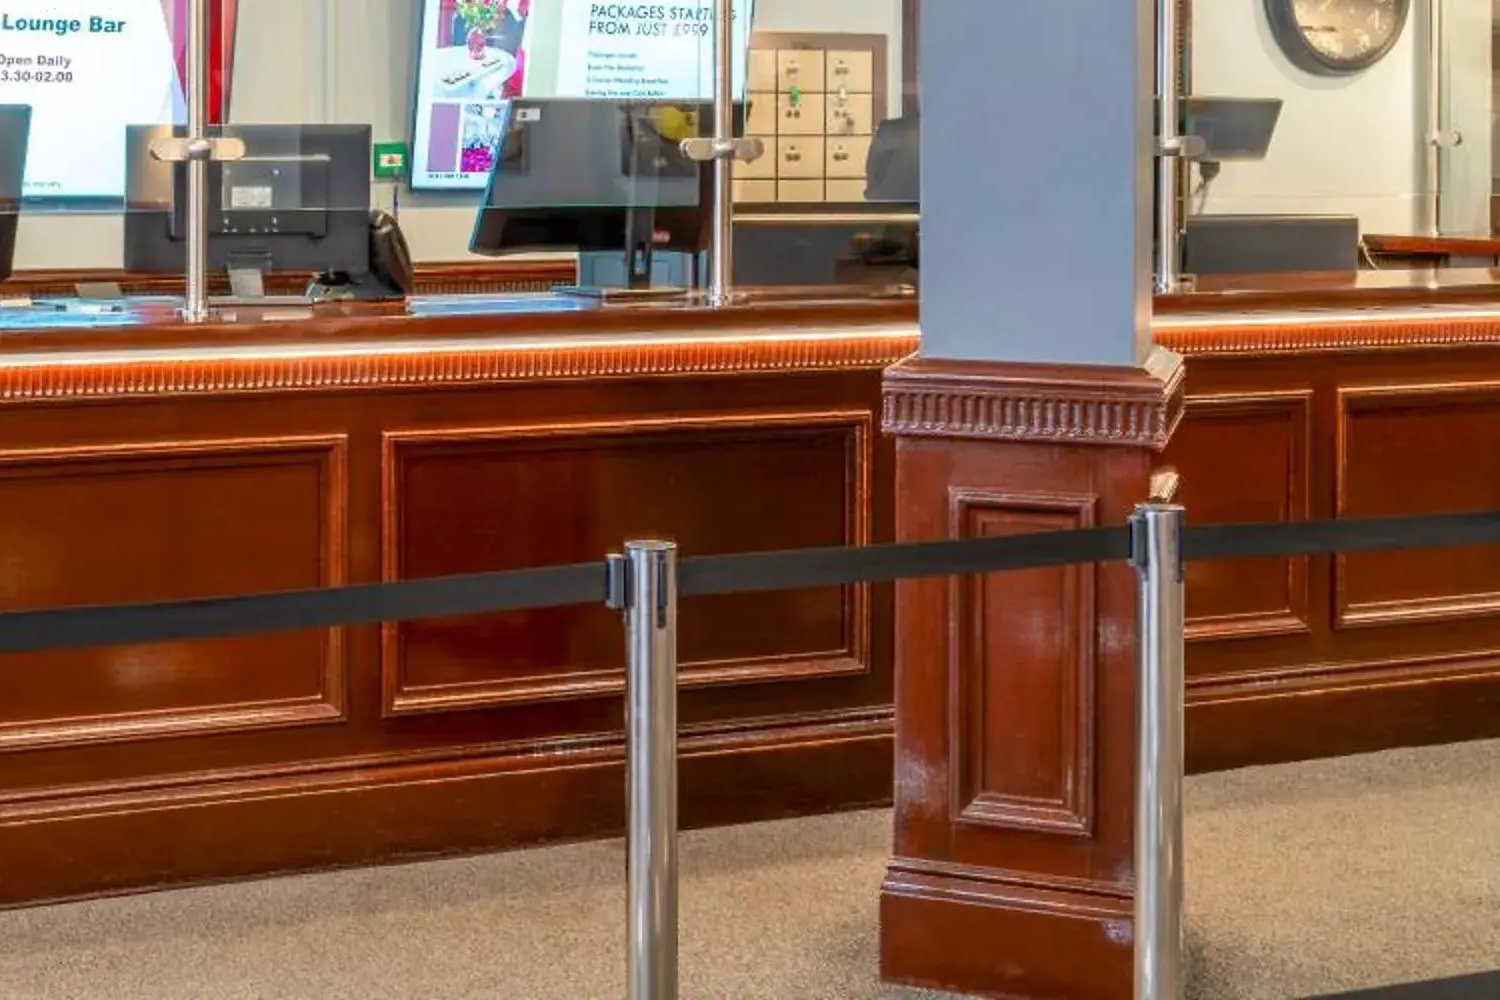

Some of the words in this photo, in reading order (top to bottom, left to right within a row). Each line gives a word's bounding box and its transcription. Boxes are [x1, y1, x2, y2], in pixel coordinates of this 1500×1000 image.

[591, 3, 665, 20] PACKAGES
[2, 13, 81, 37] Lounge
[89, 15, 127, 33] Bar
[589, 21, 631, 36] FROM
[636, 22, 667, 37] JUST
[37, 55, 71, 69] Daily
